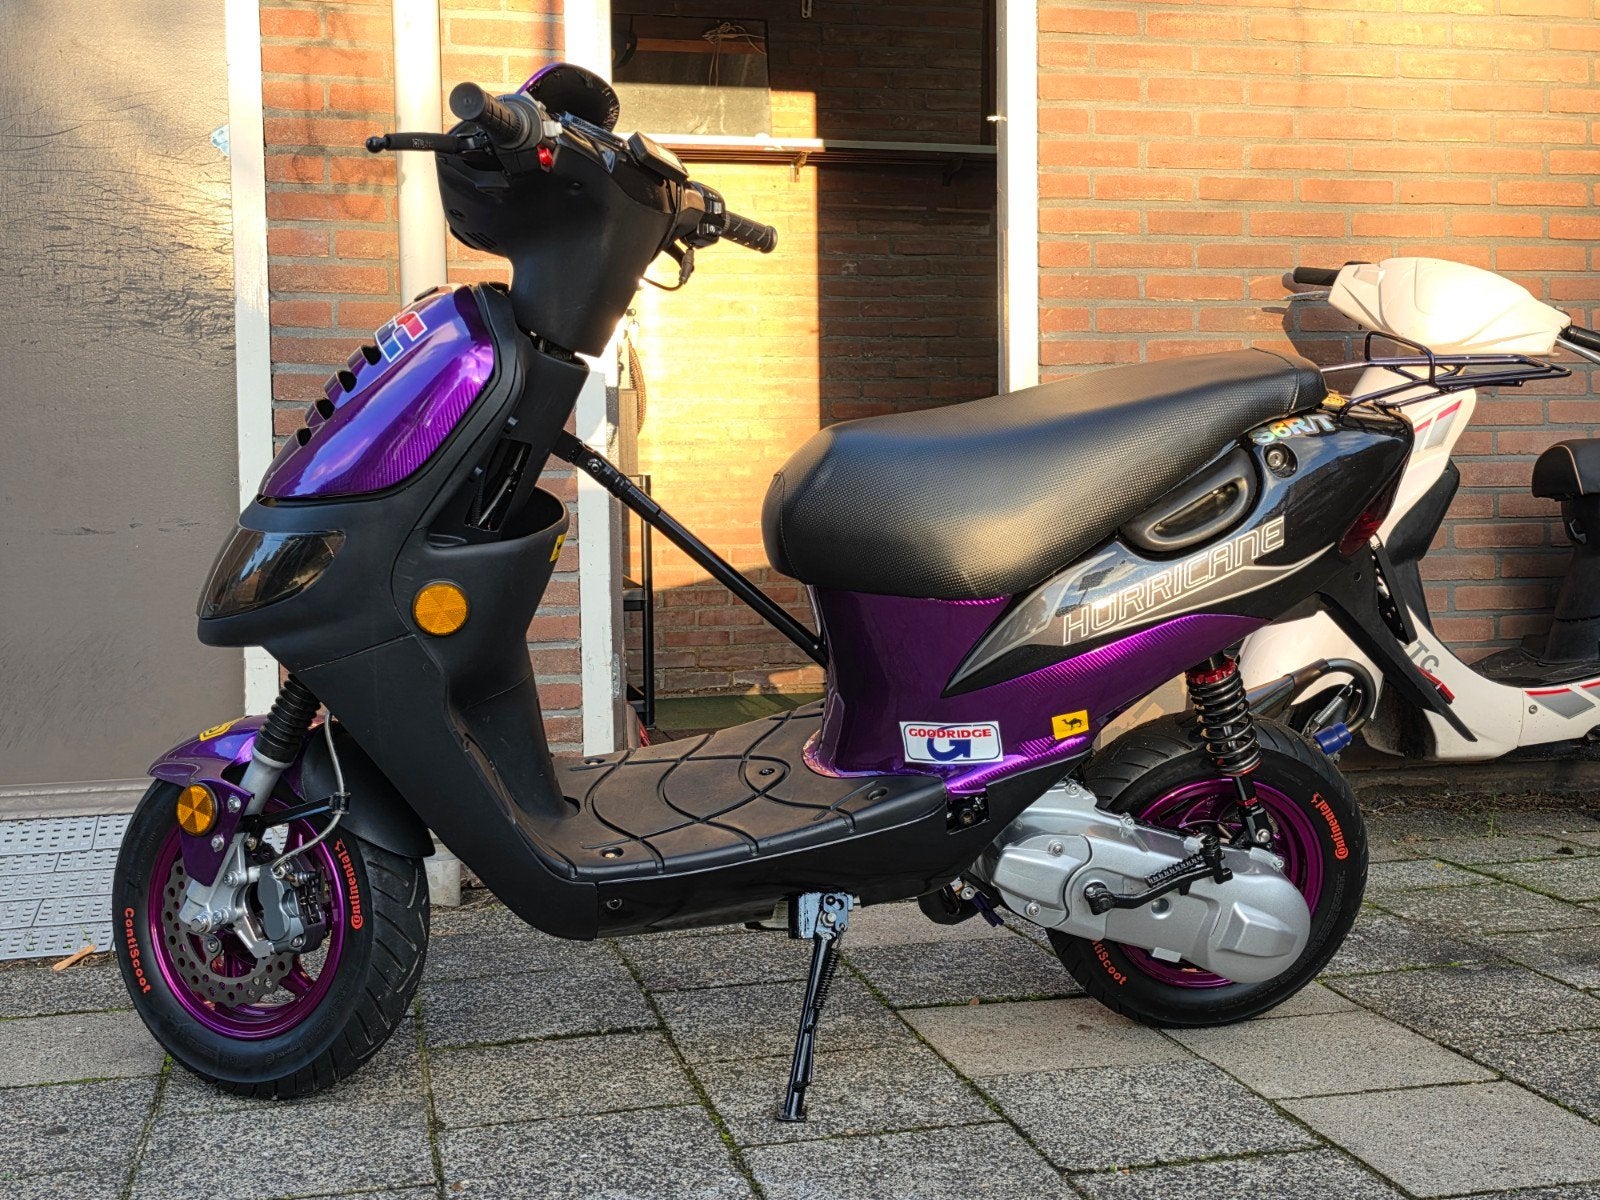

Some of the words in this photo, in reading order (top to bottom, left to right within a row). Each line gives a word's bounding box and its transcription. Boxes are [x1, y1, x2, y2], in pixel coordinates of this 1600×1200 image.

[1063, 516, 1285, 646] HURRICANE
[1401, 639, 1440, 674] TC
[908, 728, 992, 739] GOODRIDGE
[1315, 800, 1349, 860] Continental
[338, 850, 363, 930] Continental
[124, 907, 152, 994] ContiScoot
